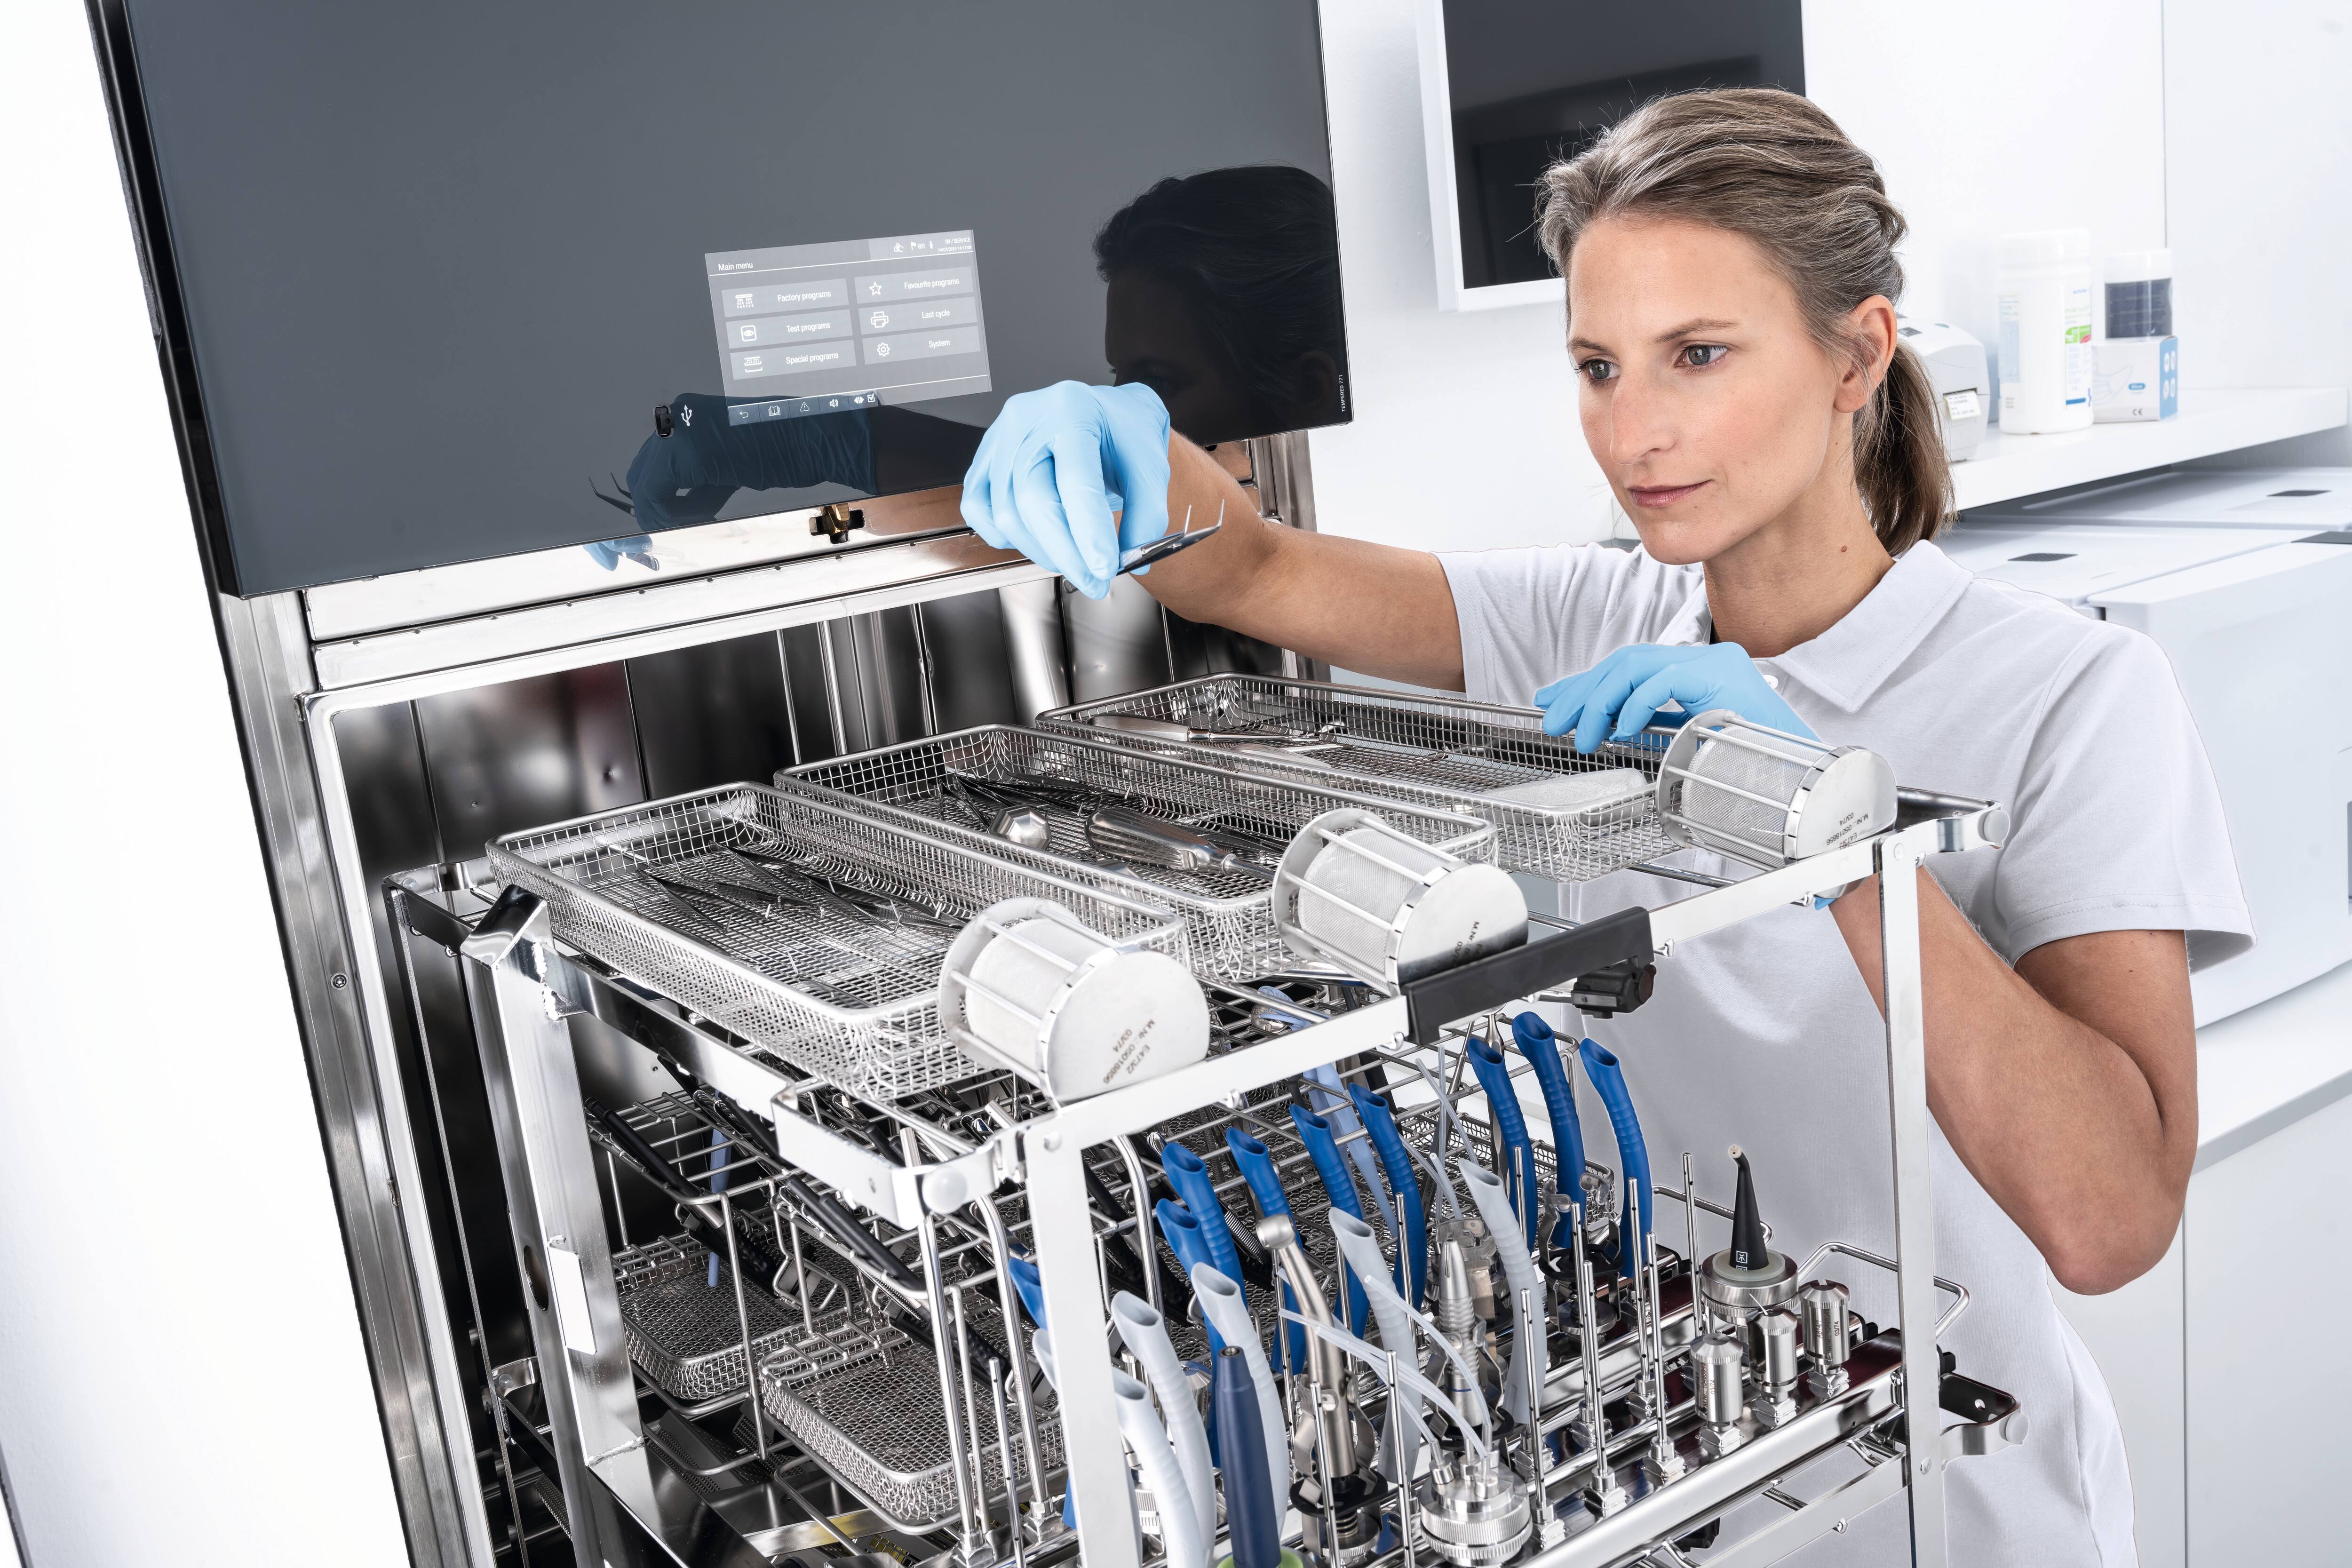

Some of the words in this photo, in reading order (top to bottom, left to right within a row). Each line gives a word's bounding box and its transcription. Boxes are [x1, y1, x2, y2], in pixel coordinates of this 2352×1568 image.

[718, 263, 735, 271] Main
[904, 280, 931, 290] Favourite
[932, 278, 960, 288] programs
[777, 294, 801, 302] Factory
[802, 291, 832, 302] programs
[922, 310, 934, 319] Last
[935, 309, 950, 318] cycle
[786, 325, 800, 333] Test
[801, 322, 831, 333] programs
[929, 339, 950, 349] System
[786, 354, 809, 366] Special
[809, 352, 839, 363] programs
[1839, 812, 1854, 826] 03/74
[1826, 824, 1852, 846] 05018856
